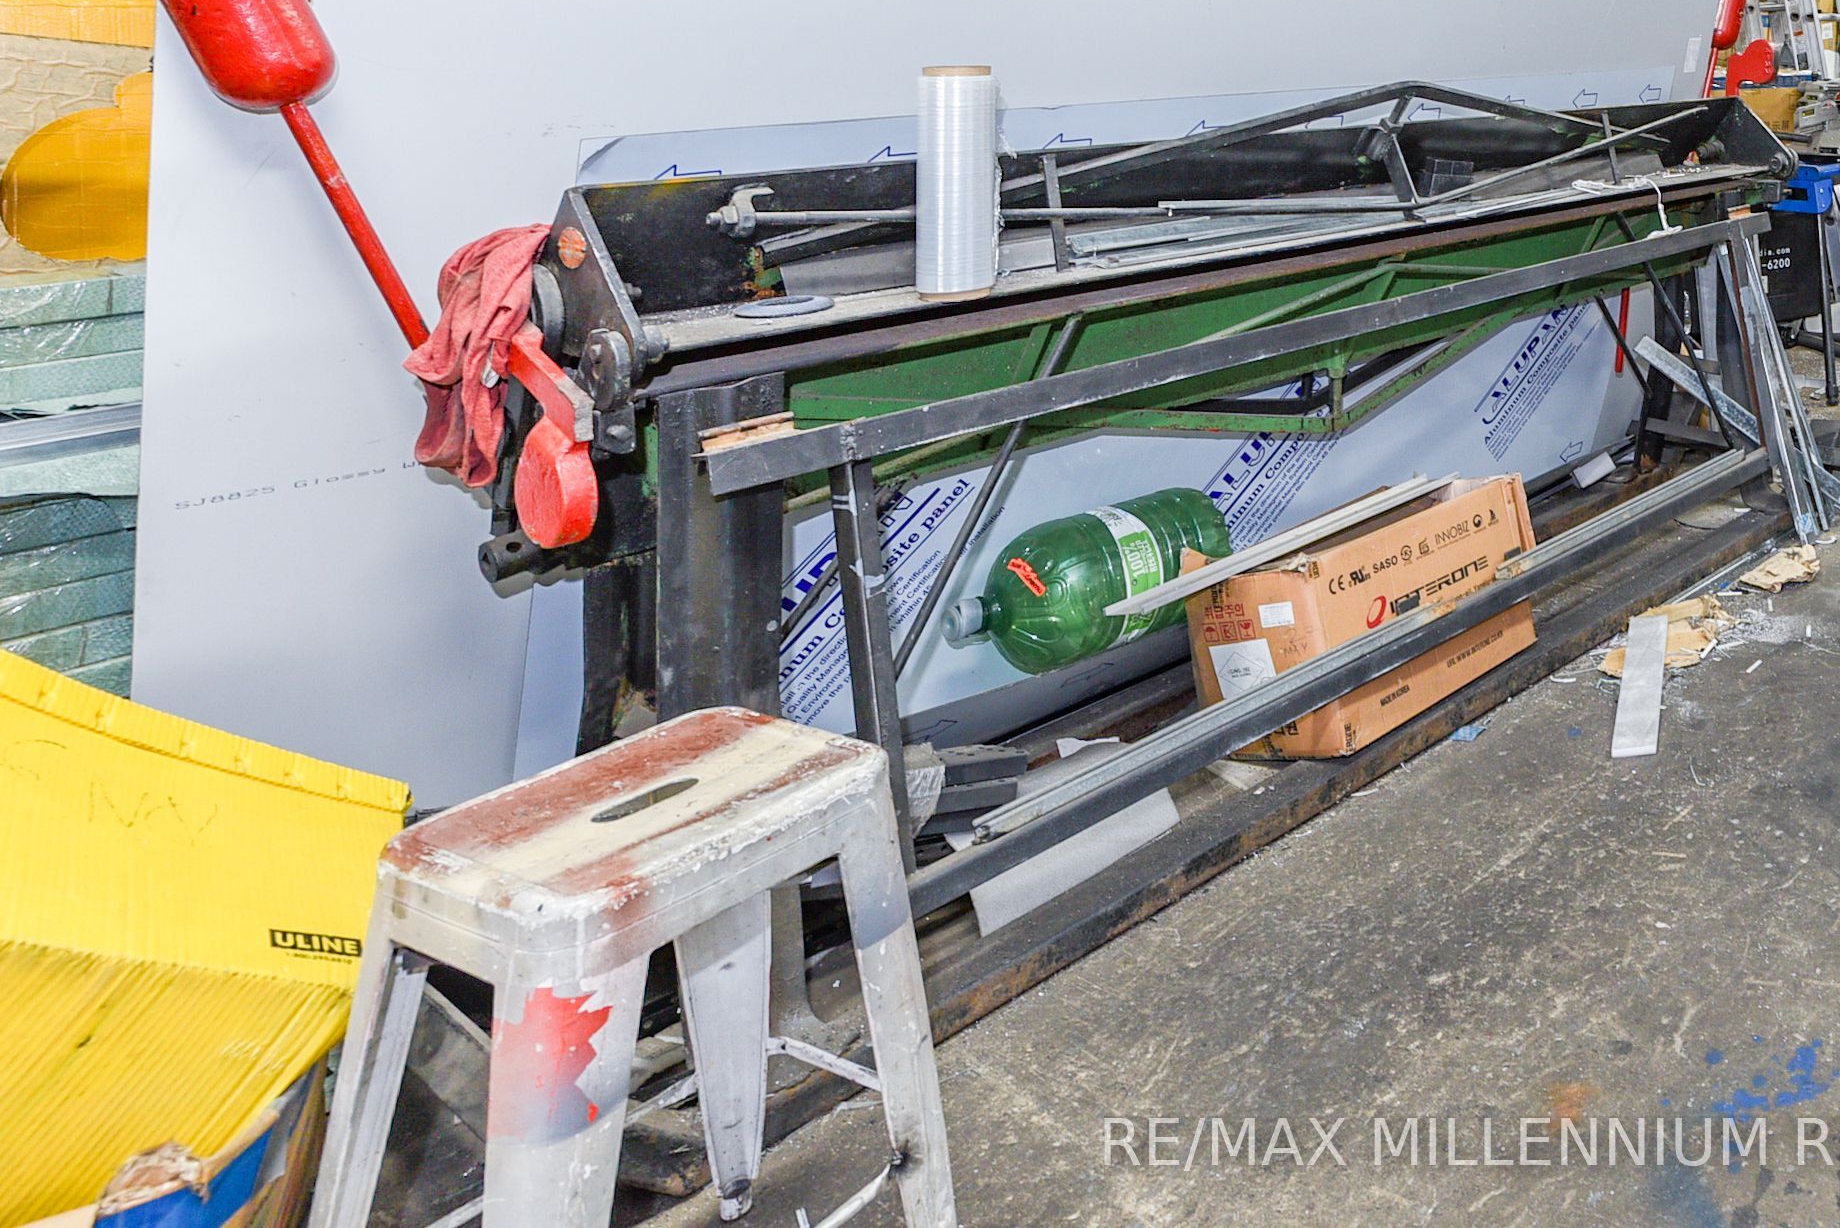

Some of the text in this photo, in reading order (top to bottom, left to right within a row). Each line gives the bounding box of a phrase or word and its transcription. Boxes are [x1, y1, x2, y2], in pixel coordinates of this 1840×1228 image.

[1483, 300, 1590, 445] Aluminum Composite panel
[174, 466, 388, 512] SJ8825 Glossy
[921, 477, 971, 533] panel
[968, 505, 1007, 548] installation
[1433, 519, 1471, 546] INNOBIZ
[895, 549, 942, 598] Certification
[1122, 541, 1145, 579] 100%
[1371, 554, 1399, 575] SASO
[786, 682, 818, 715] Quality
[274, 932, 359, 956] ULINE
